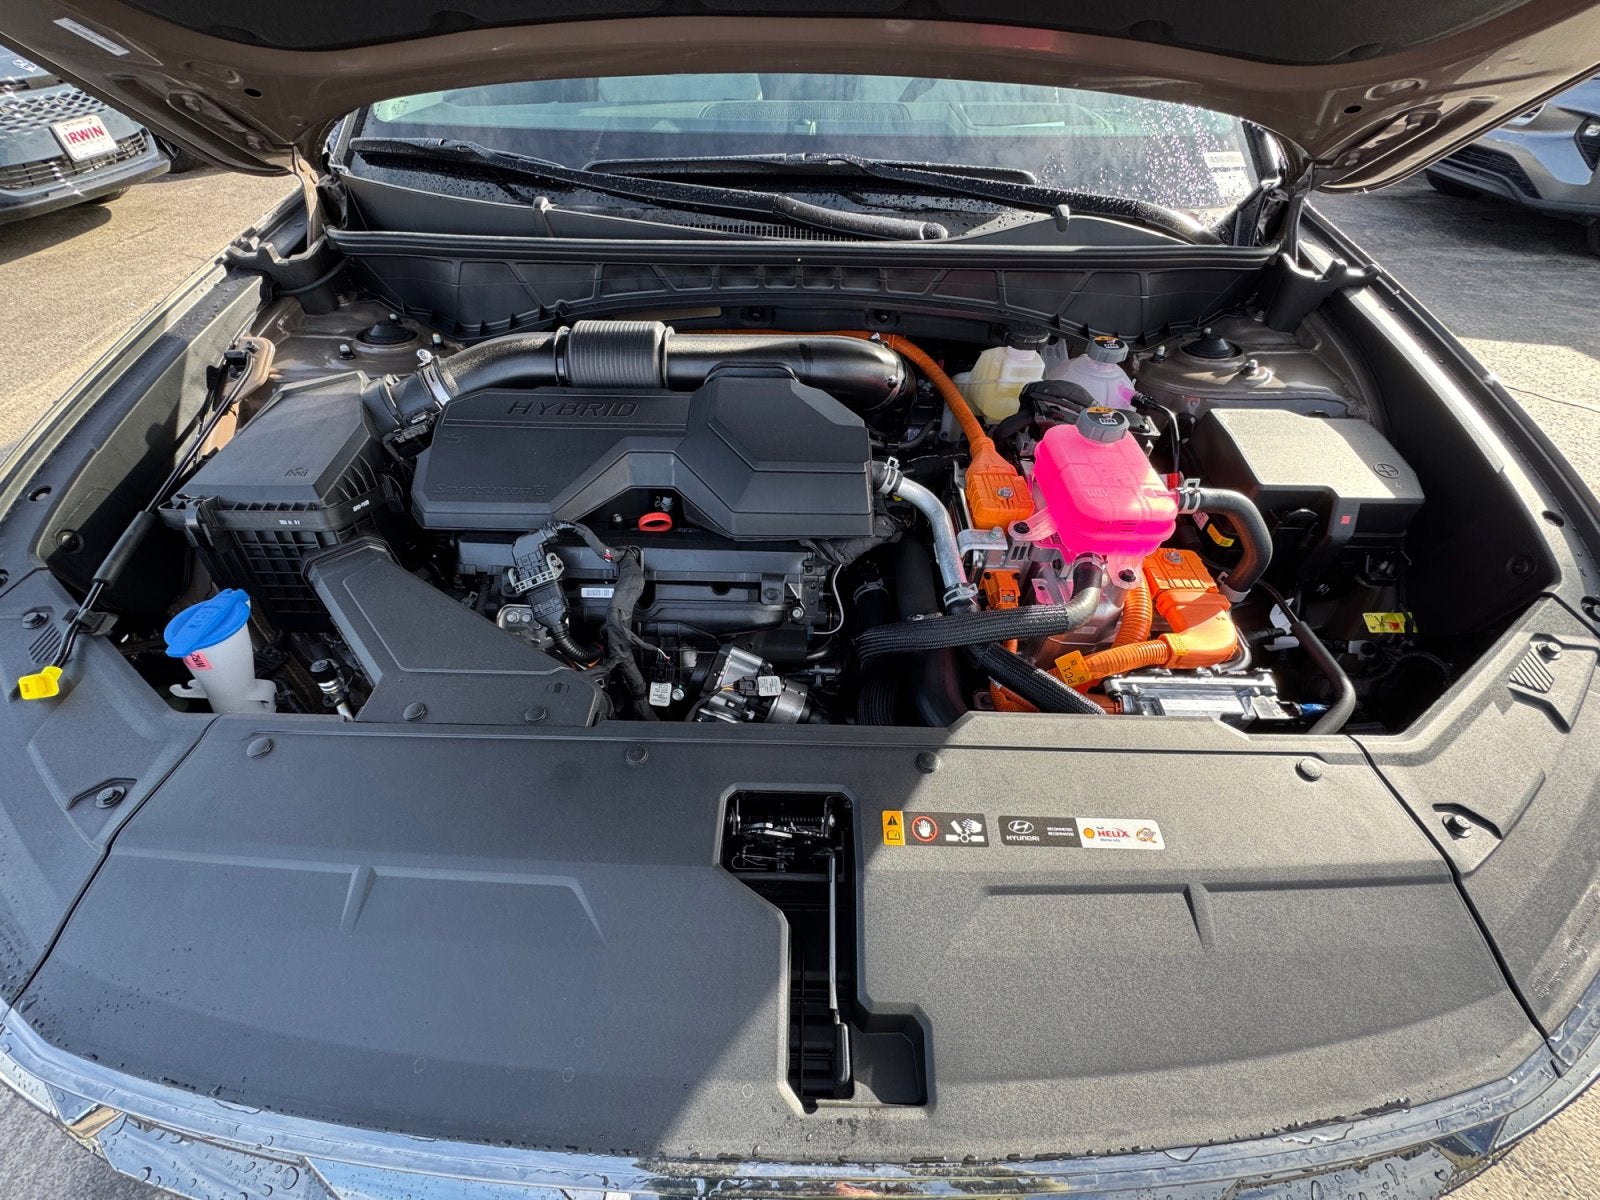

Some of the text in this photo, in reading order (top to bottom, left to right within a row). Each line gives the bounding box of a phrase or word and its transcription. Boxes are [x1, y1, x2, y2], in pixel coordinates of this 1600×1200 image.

[64, 125, 105, 145] IRWIN
[507, 400, 639, 417] HYBRID
[1097, 830, 1130, 838] HELIX
